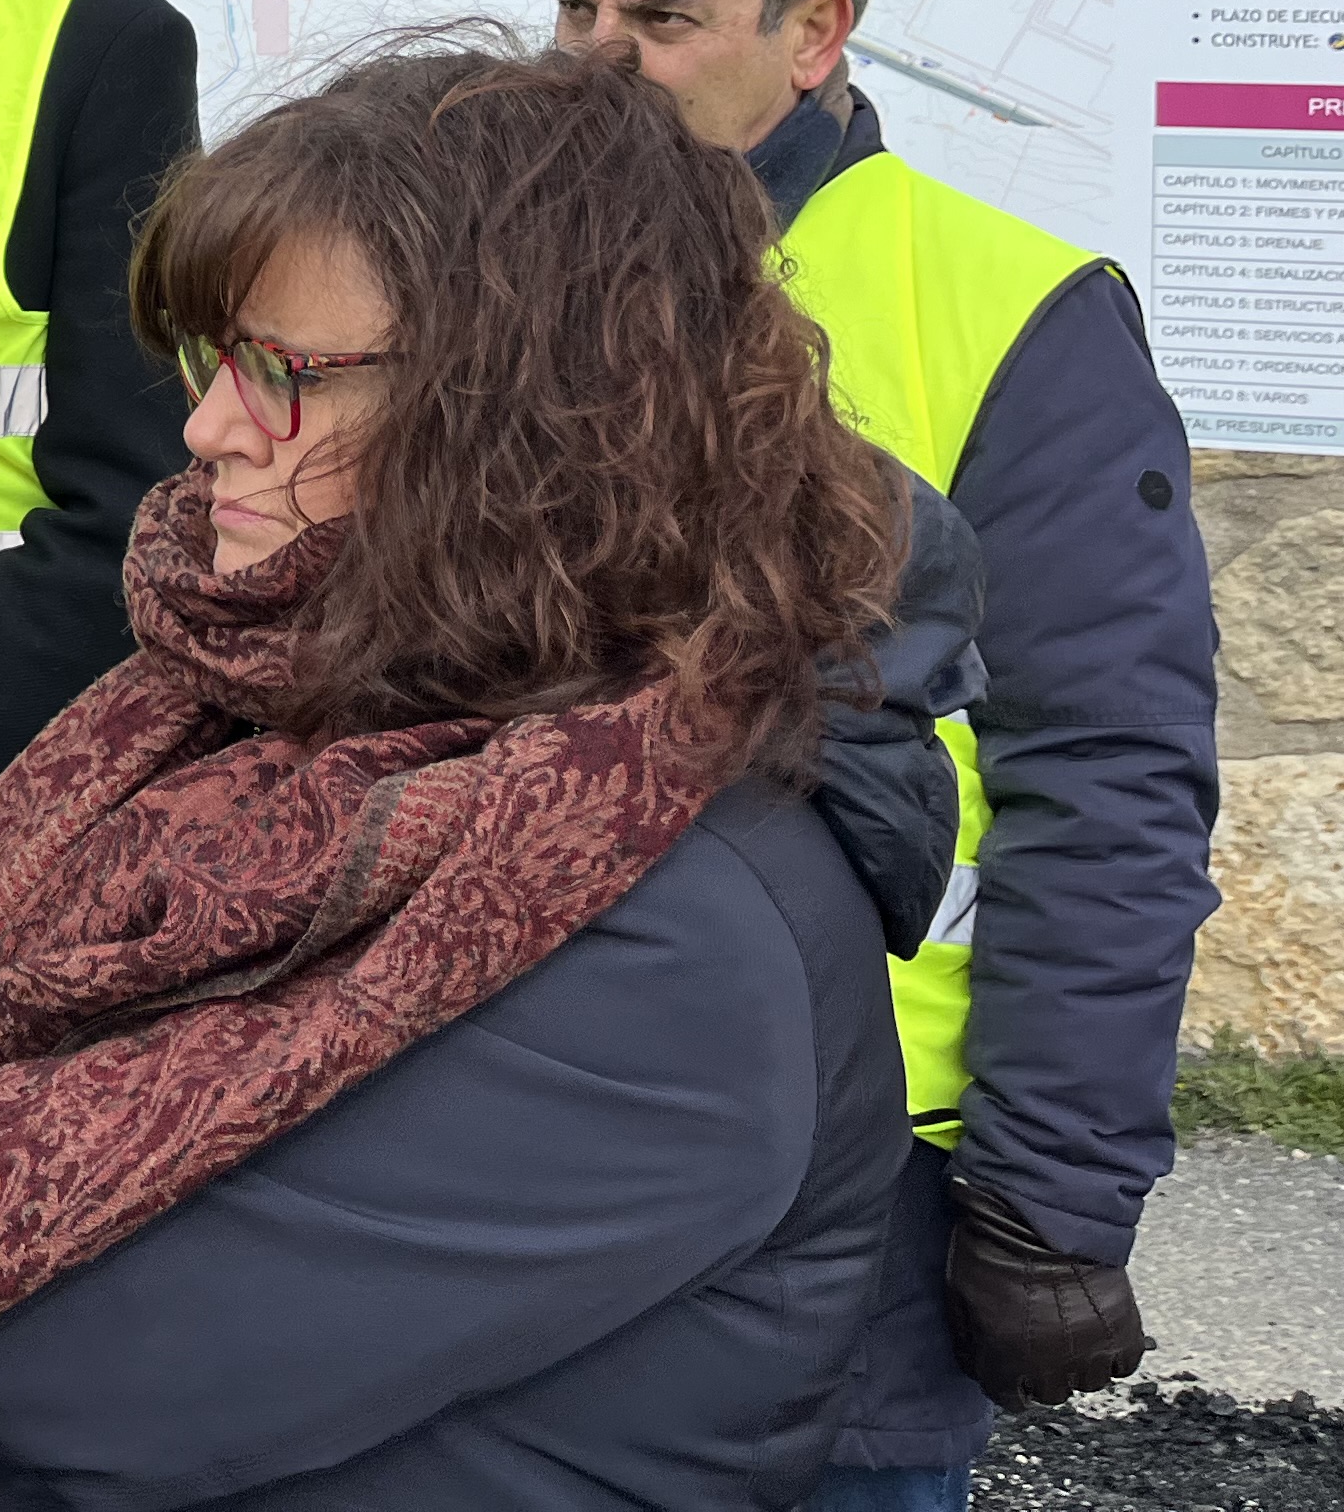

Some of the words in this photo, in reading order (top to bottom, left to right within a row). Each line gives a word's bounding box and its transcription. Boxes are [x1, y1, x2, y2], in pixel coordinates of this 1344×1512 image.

[1211, 8, 1262, 23] PLAZO
[1267, 9, 1288, 23] DE
[1292, 9, 1344, 23] EJECU
[1211, 33, 1319, 49] CONSTRUYE:
[1308, 97, 1344, 116] PR
[1261, 145, 1342, 160] CAPÍTULO
[1163, 173, 1237, 188] CAPÍTULO
[1163, 202, 1236, 217] CAPÍTULO
[1255, 206, 1310, 219] FIRMES
[1313, 207, 1325, 219] Y
[1162, 232, 1235, 247] CAPÍTULO
[1255, 237, 1324, 250] DRENAJE
[1162, 263, 1236, 278] CAPÍTULO
[1161, 293, 1235, 309] CAPÍTULO
[1254, 298, 1344, 313] ESTRUCTUR
[1161, 324, 1234, 339] CAPÍTULO
[1254, 329, 1334, 344] SERVICIOS
[1161, 355, 1234, 370] CAPÍTULO
[1253, 359, 1344, 375] ORDENACIÓ
[1252, 391, 1309, 405] VARIOS
[1182, 417, 1212, 430] TAL
[1216, 418, 1338, 437] PRESUPUESTO
